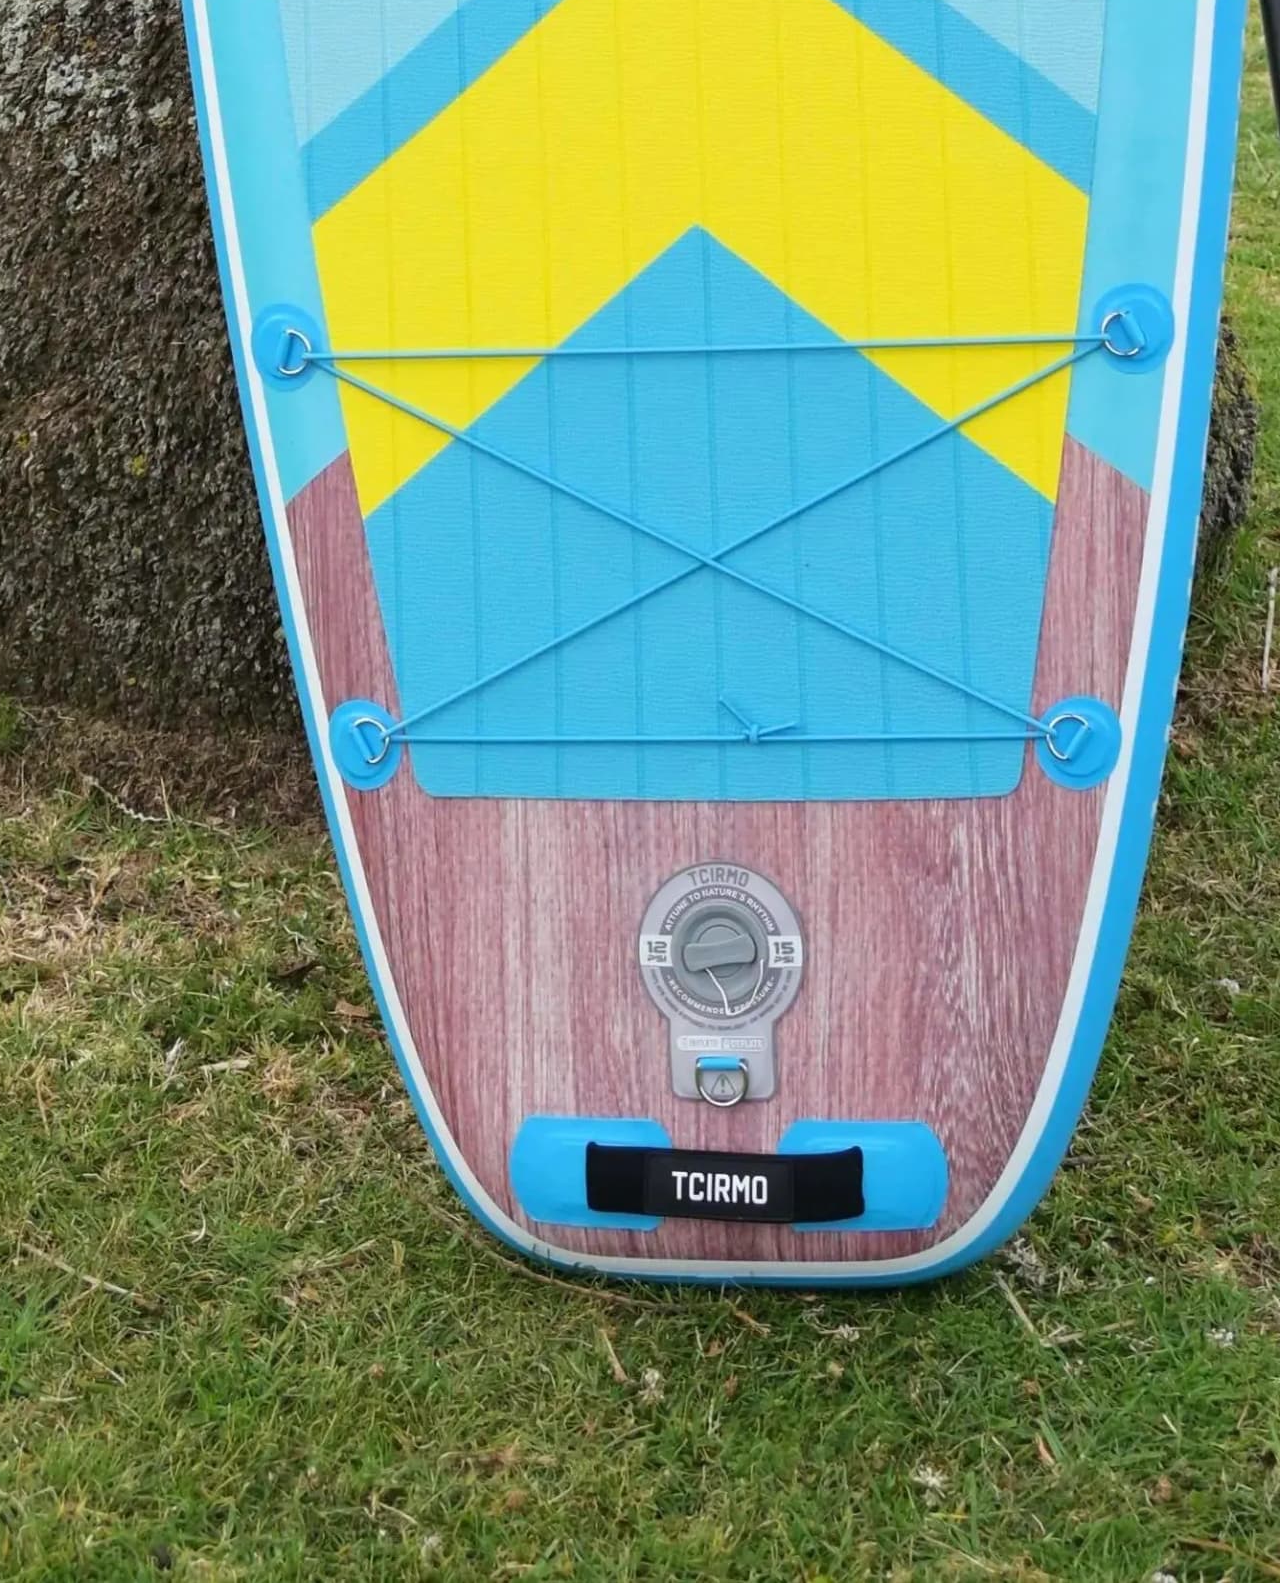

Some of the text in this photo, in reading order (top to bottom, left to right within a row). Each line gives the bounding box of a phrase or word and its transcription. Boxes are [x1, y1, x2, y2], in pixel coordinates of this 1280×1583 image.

[687, 866, 750, 888] TCIRMO
[664, 898, 689, 932] ATTUNE
[689, 891, 701, 903] TO
[647, 940, 668, 954] 12
[773, 941, 795, 955] 15
[671, 1170, 768, 1205] TCIRMO
